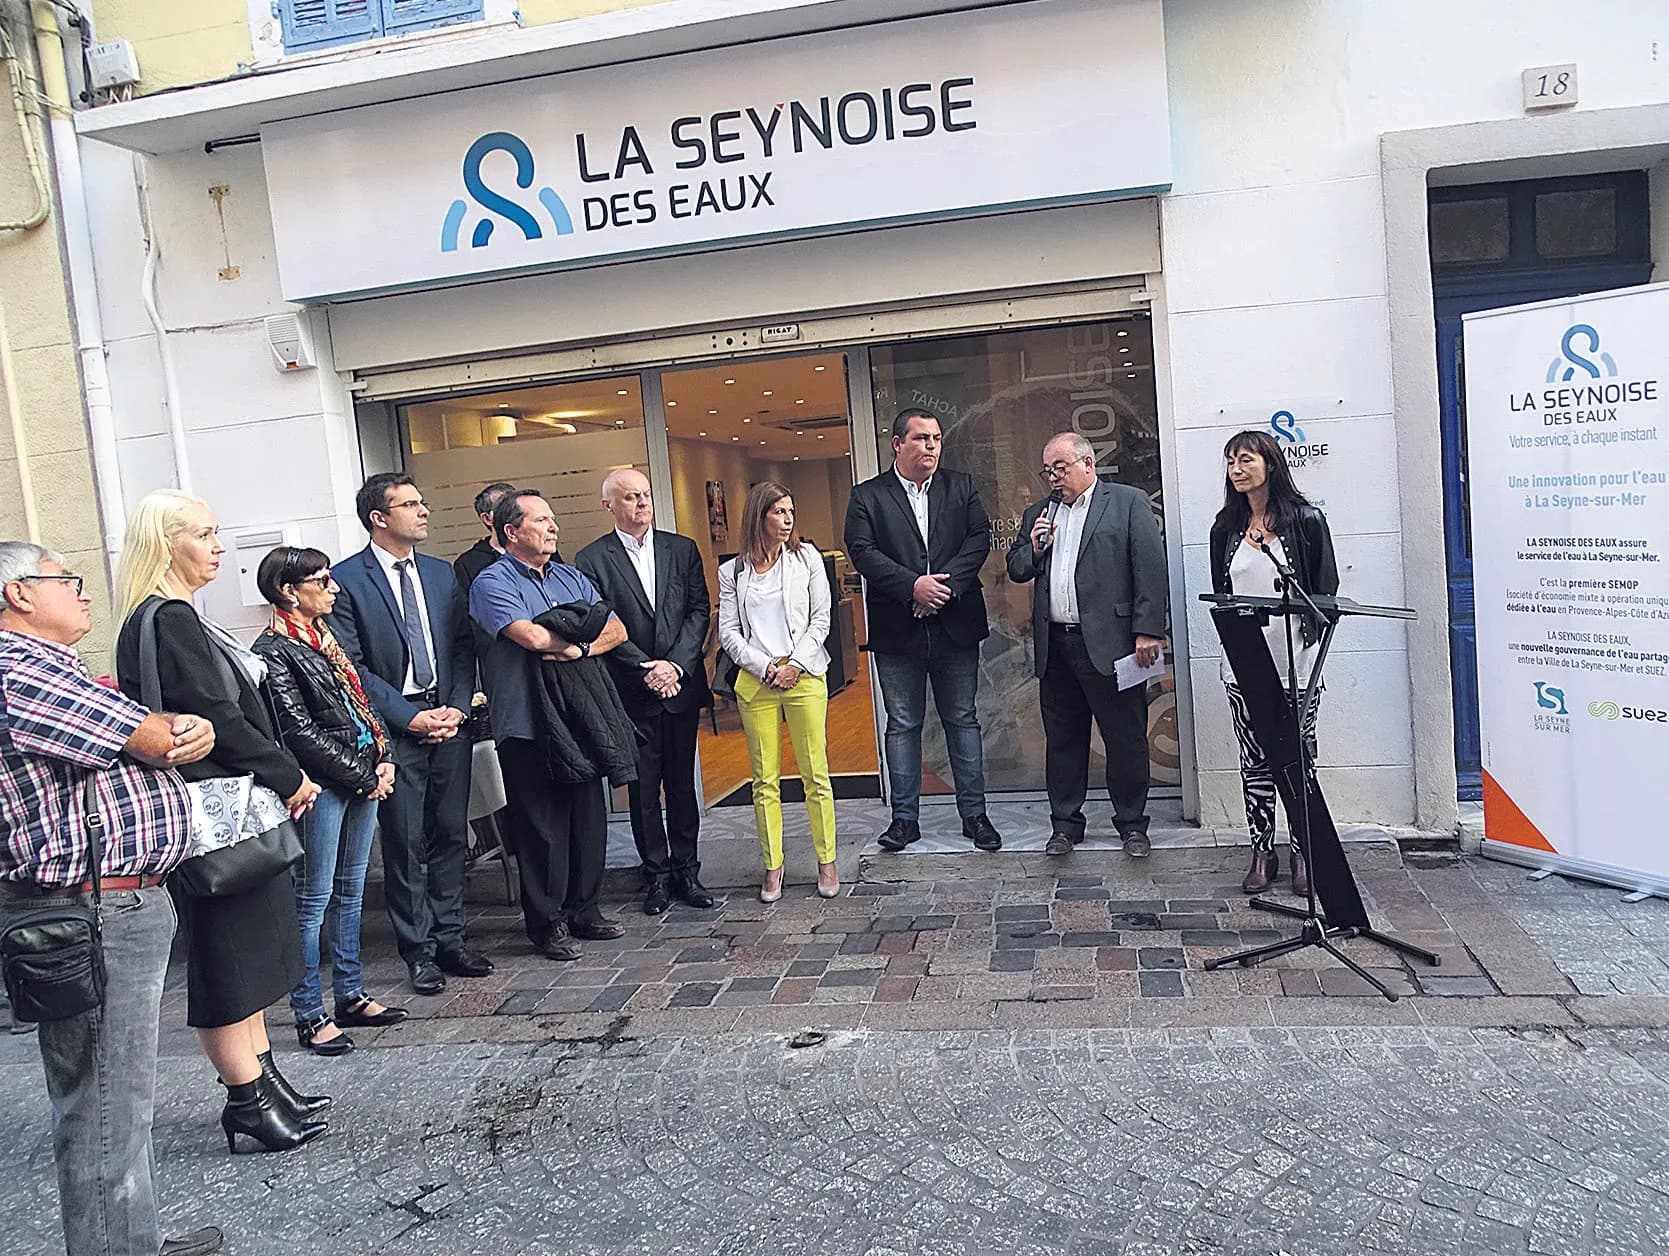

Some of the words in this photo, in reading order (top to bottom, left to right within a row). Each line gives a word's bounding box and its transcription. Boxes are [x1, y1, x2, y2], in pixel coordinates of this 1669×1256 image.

[1534, 72, 1570, 98] 18
[575, 126, 654, 183] LA
[671, 77, 977, 170] SEYNOISE
[583, 189, 657, 231] DES
[669, 171, 776, 219] EAUX
[1510, 392, 1537, 412] LA
[1543, 380, 1658, 409] SEYNOISE
[1543, 411, 1572, 426] DES
[1576, 408, 1617, 424] EAUX
[1509, 434, 1533, 448] Votre
[1534, 431, 1571, 447] service,
[1581, 429, 1618, 446] chaque
[1620, 425, 1658, 441] instant
[1508, 475, 1530, 489] Une
[1532, 472, 1597, 488] innovation
[1599, 473, 1629, 488] pour
[1632, 470, 1666, 484] l'eau
[1525, 495, 1532, 508] à
[1535, 495, 1549, 508] La
[1551, 492, 1647, 510] Seyne-sur-Mer
[1526, 538, 1537, 547] LA
[1538, 537, 1577, 548] SEYNOISE
[1577, 538, 1593, 548] DES
[1595, 538, 1617, 548] EAUX
[1618, 539, 1648, 548] assure
[1517, 551, 1524, 560] le
[1524, 552, 1551, 561] service
[1552, 551, 1562, 561] de
[1562, 551, 1582, 561] l'eau
[1582, 551, 1588, 561] à
[1588, 552, 1598, 561] La
[1598, 552, 1660, 563] Seyne-sur-Mer.
[1560, 578, 1567, 588] la
[1568, 579, 1607, 590] première
[1608, 580, 1639, 590] SEMOP
[1530, 603, 1536, 613] à
[1607, 594, 1644, 606] opération
[1547, 631, 1557, 640] LA
[1558, 631, 1591, 643] SEYNOISE
[1593, 633, 1608, 644] DES
[1520, 643, 1554, 653] nouvelle
[1554, 645, 1605, 657] gouvernance
[1606, 648, 1617, 658] de
[1640, 652, 1669, 664] partag
[1517, 656, 1535, 665] entre
[1536, 656, 1543, 665] la
[1544, 656, 1560, 667] Ville
[1561, 658, 1570, 668] de
[1571, 659, 1580, 669] La
[1580, 659, 1634, 673] Seyne-sur-Mer
[1635, 665, 1644, 674] et
[1545, 716, 1570, 725] SEYNE
[1621, 706, 1668, 723] suez
[1534, 723, 1551, 731] SUR
[1553, 725, 1570, 734] MER
